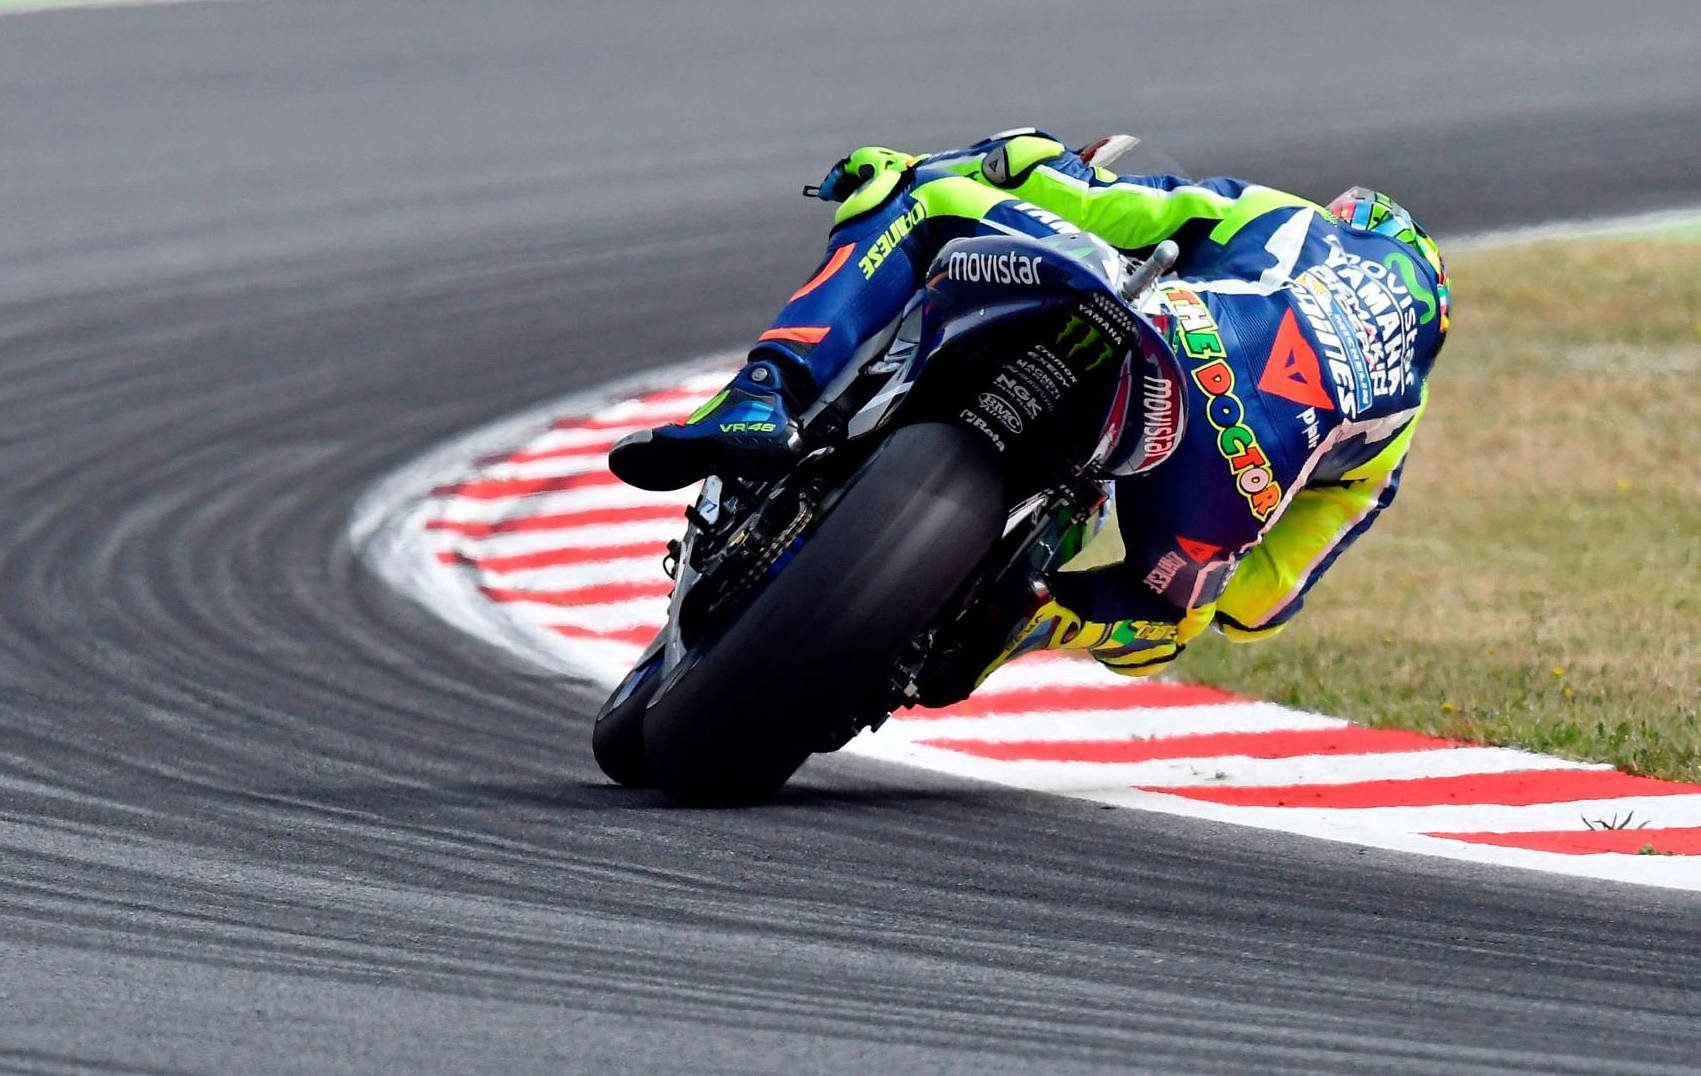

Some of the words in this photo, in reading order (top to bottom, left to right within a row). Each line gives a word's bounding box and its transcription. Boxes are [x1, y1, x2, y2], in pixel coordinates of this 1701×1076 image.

[949, 250, 1042, 285] movistar
[1079, 303, 1123, 345] YAMAHA
[1162, 286, 1228, 360] THE
[983, 396, 1021, 430] BMC
[996, 373, 1043, 417] NGK
[1143, 375, 1177, 457] movistar
[1190, 358, 1283, 522] DOCTOR
